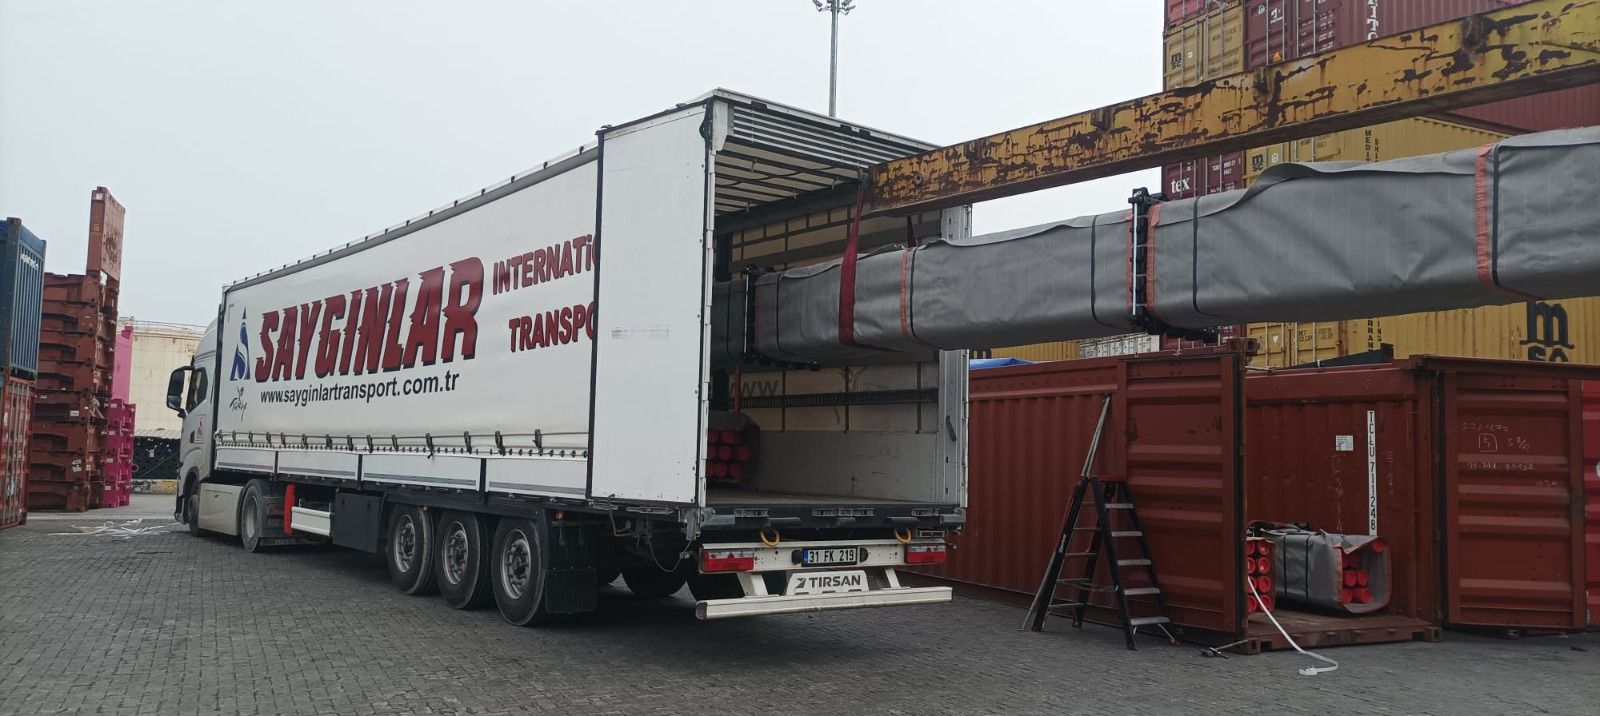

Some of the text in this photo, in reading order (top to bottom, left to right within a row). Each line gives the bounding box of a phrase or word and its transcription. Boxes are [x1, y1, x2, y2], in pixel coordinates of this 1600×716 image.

[255, 257, 484, 383] SAYGINLAR
[809, 549, 854, 562] 31 FK 219
[809, 575, 861, 588] TIRSAN
